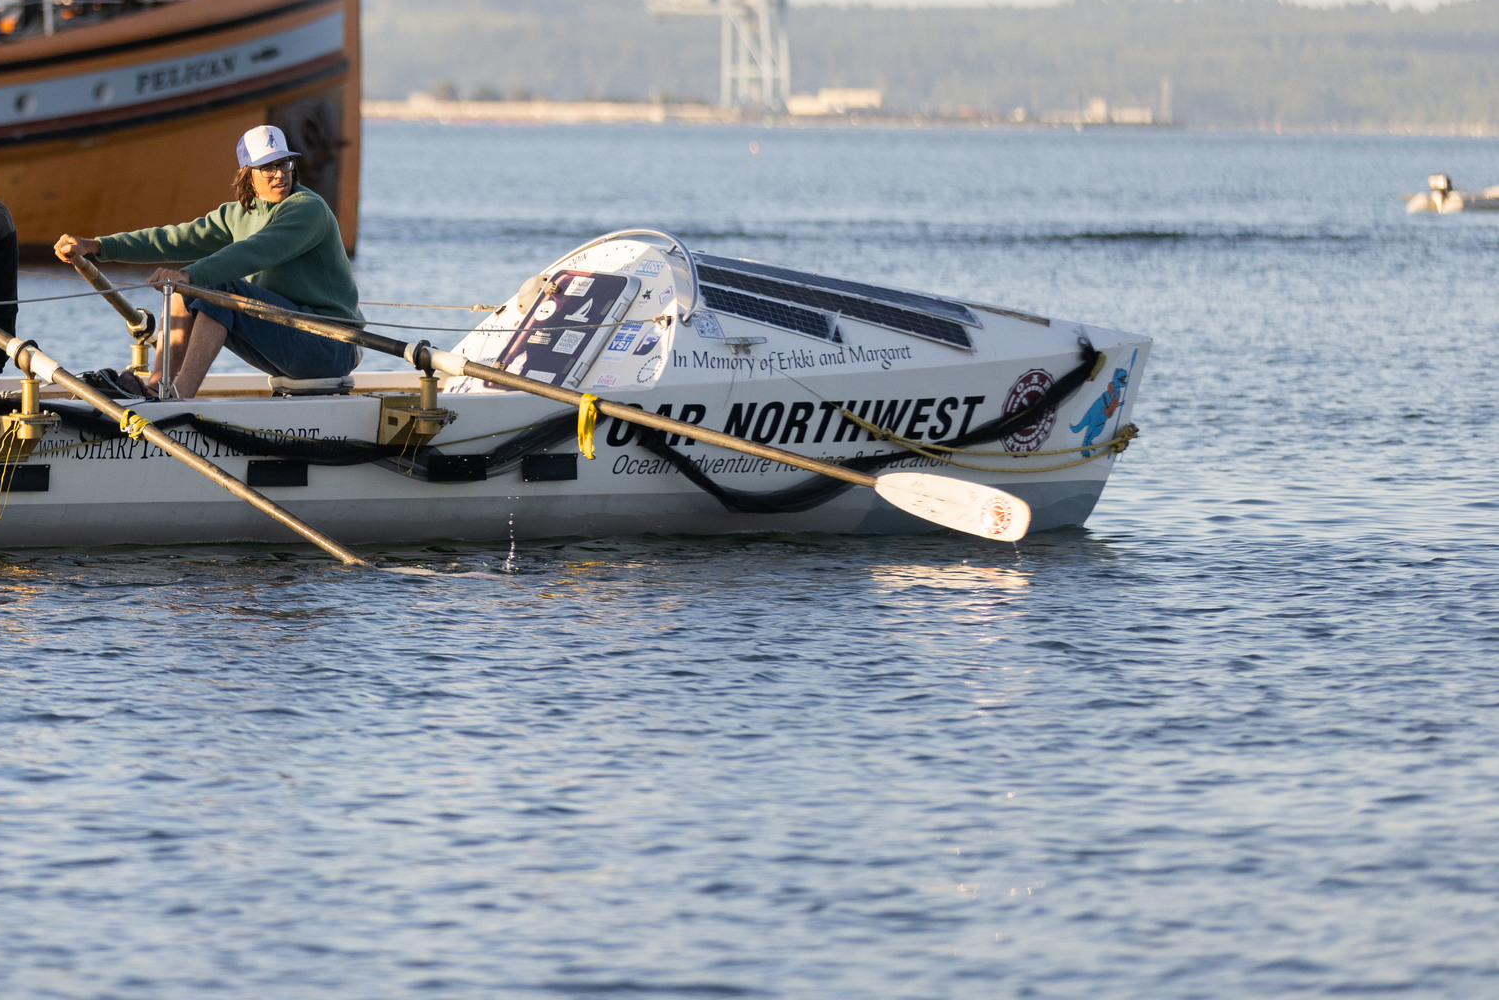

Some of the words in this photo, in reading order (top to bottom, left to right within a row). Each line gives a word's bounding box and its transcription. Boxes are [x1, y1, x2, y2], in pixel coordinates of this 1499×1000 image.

[135, 55, 238, 96] PELICAN
[610, 340, 631, 352] YSI
[673, 350, 687, 368] In
[692, 350, 755, 378] Memory
[760, 351, 776, 376] of
[778, 349, 814, 370] Erkki
[819, 349, 846, 365] and
[848, 345, 913, 370] Margaret
[721, 396, 986, 445] NORTHWEST
[612, 454, 671, 475] Ocean
[676, 454, 772, 474] Adventure
